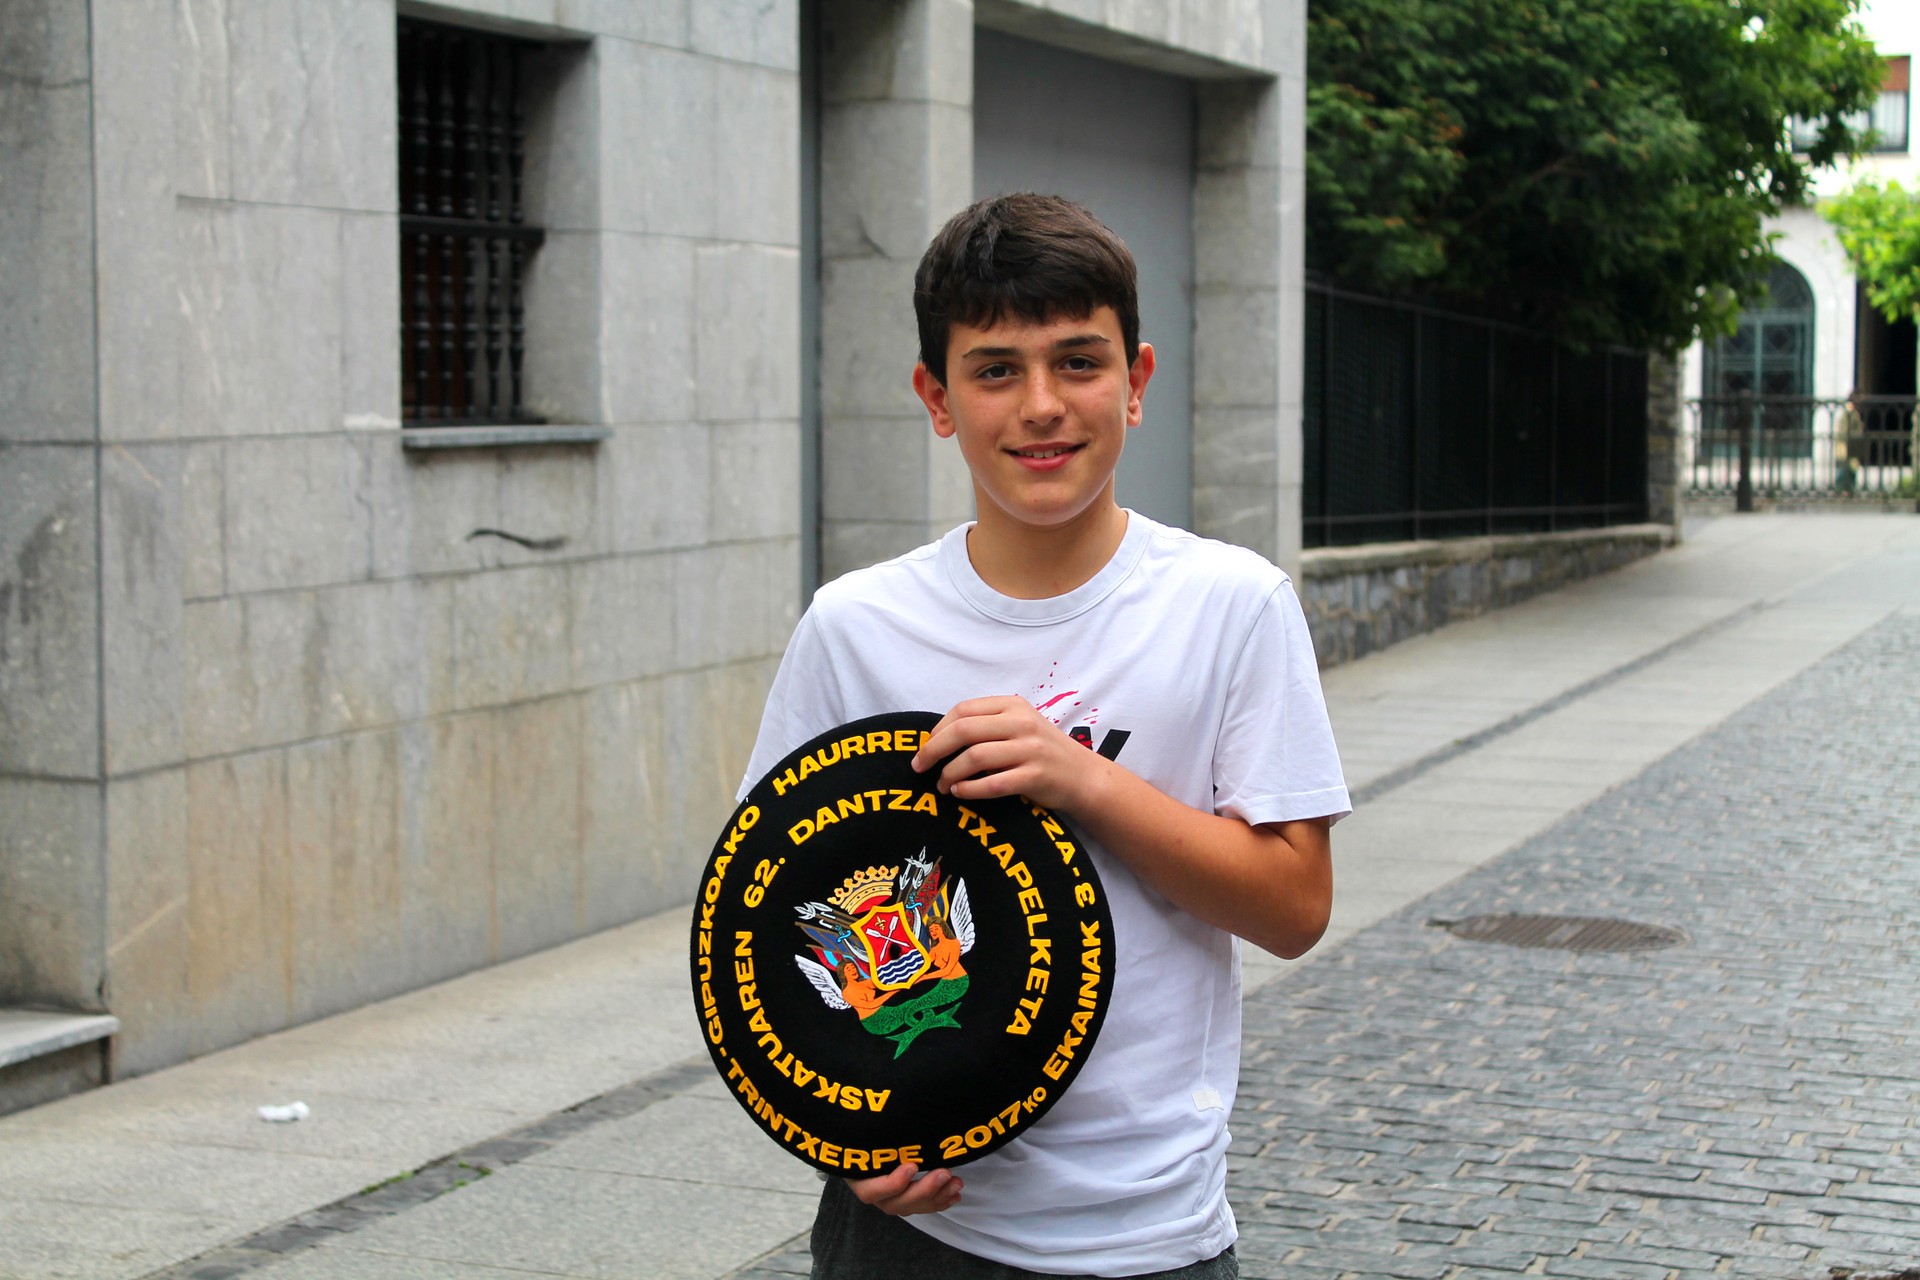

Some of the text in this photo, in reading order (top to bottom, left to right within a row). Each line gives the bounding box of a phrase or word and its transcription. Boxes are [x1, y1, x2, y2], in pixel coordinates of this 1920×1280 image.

[698, 805, 761, 1045] GIPUZKOAKO
[727, 1057, 924, 1171] TRINTXERPE
[1043, 920, 1101, 1081] EKAINAK
[734, 789, 1052, 1112] ASKATUAREN 62. DANTZA TXAPELKETA
